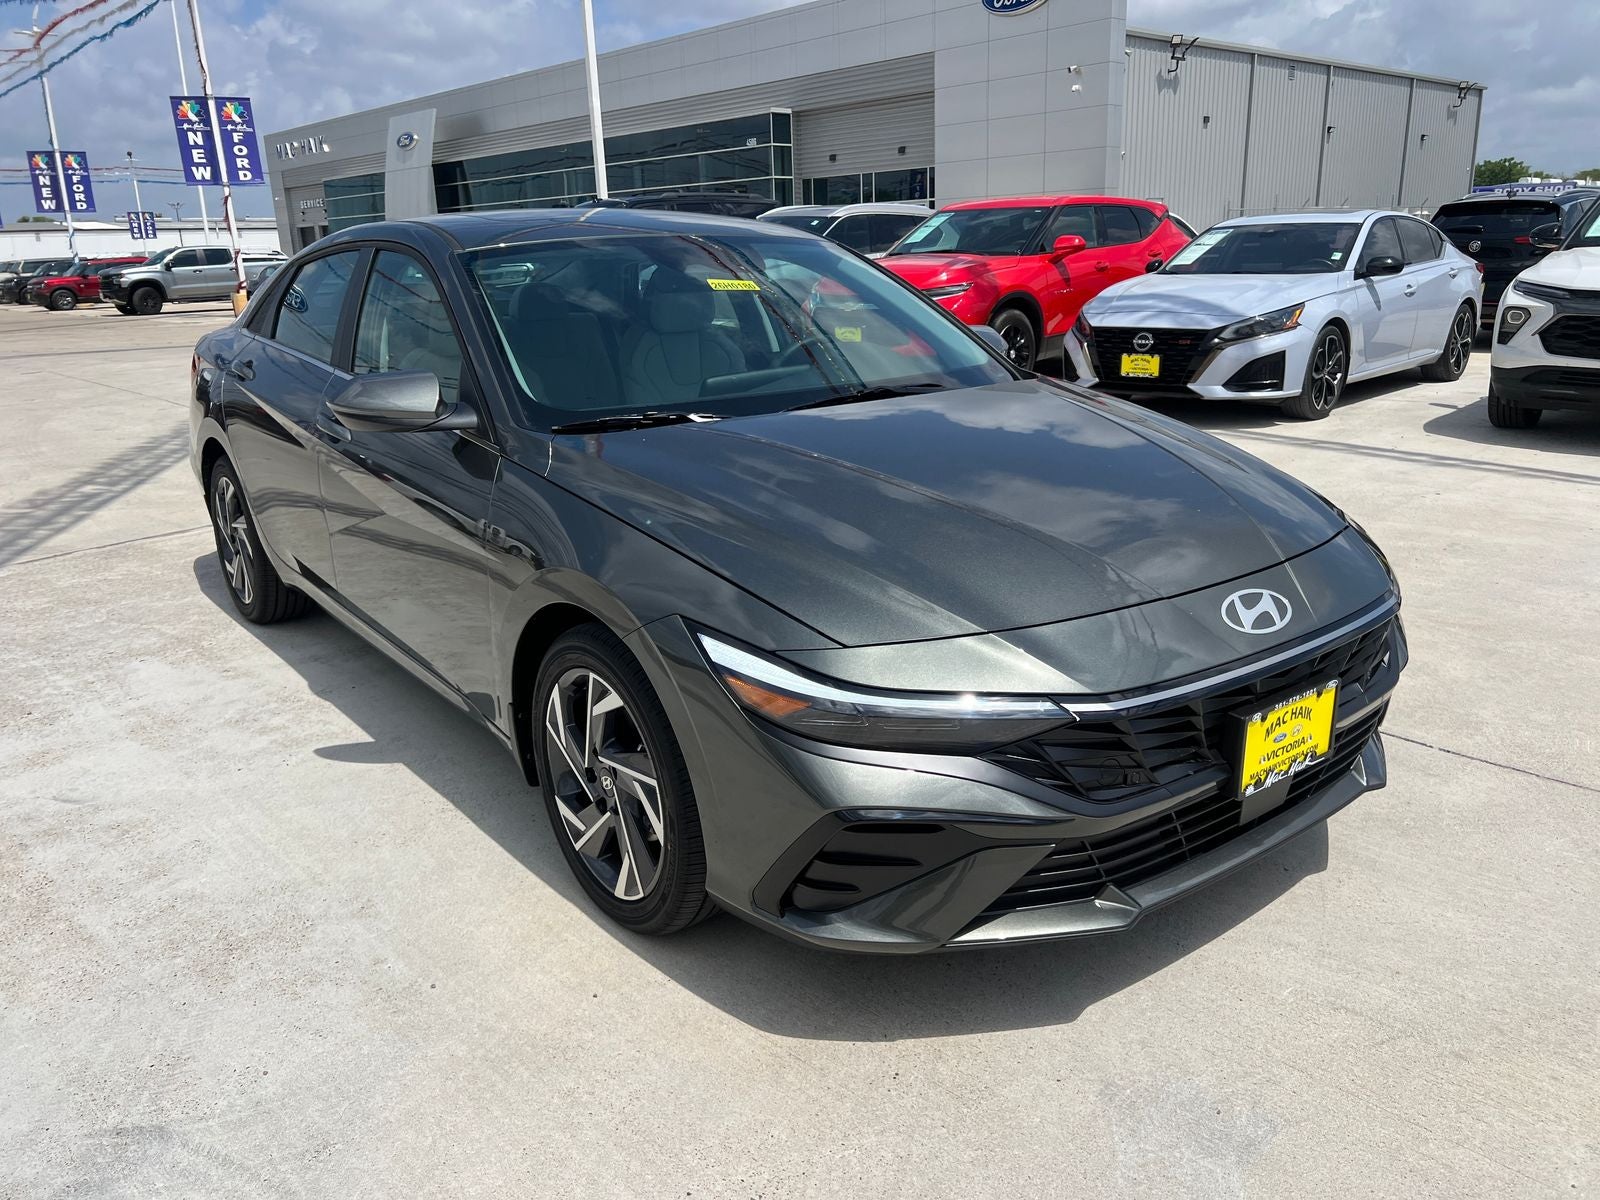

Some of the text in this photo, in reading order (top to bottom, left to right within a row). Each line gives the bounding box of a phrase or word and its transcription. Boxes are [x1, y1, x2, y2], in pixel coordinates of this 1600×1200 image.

[186, 131, 212, 181] NEW
[232, 132, 253, 181] FORD
[275, 135, 330, 160] MAC HAIK
[38, 175, 57, 210] NEW
[72, 175, 88, 210] FORD
[300, 198, 326, 209] SERVICE
[1264, 705, 1313, 742] MAC HAIK
[1266, 736, 1306, 762] VICTORIA
